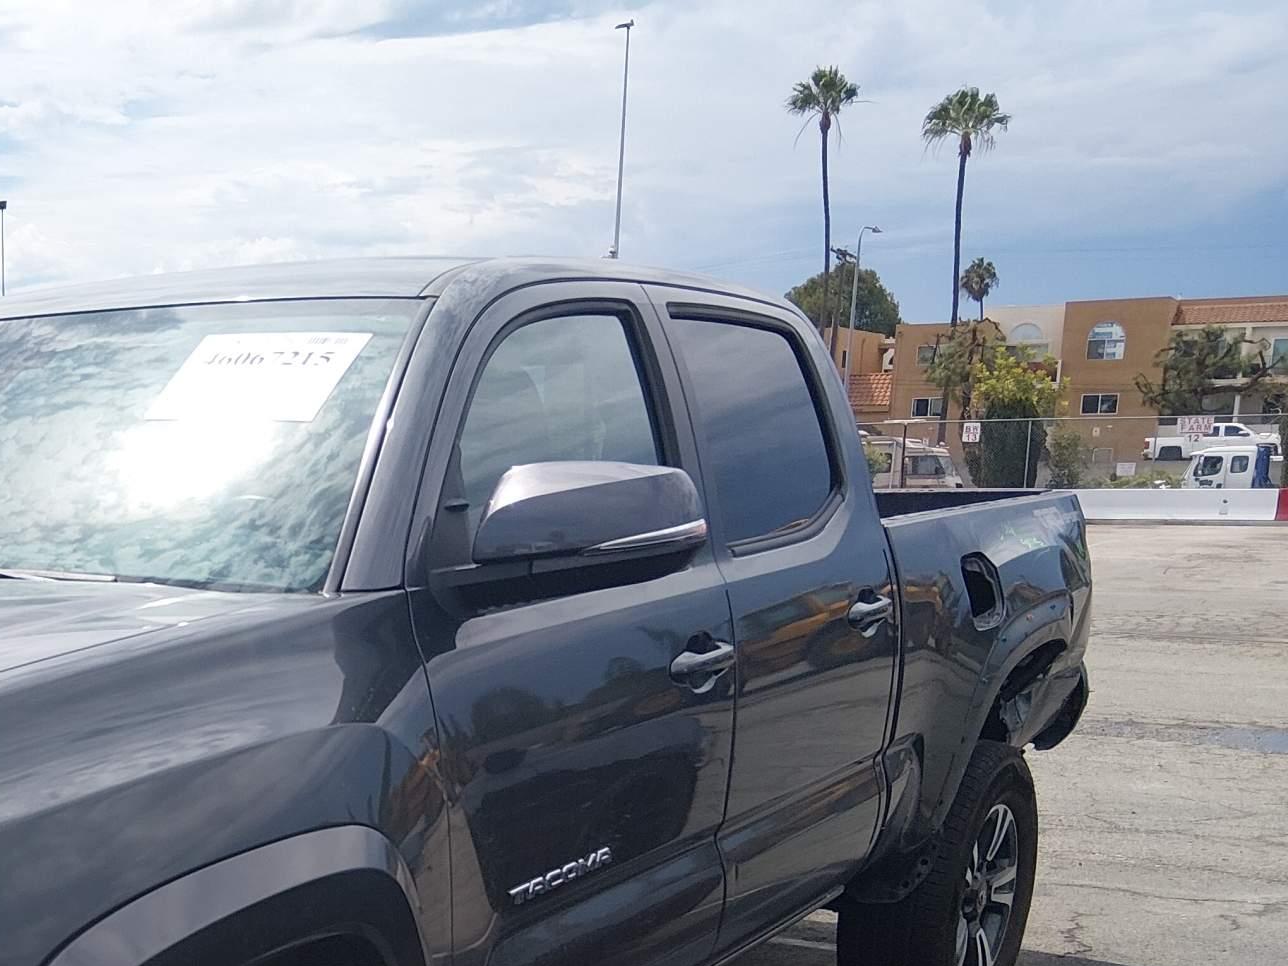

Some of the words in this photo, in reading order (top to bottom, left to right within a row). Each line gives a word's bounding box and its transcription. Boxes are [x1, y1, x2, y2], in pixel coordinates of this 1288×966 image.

[1179, 416, 1213, 425] STATE
[1180, 424, 1211, 432] FARM
[1187, 434, 1200, 442] 12
[508, 847, 612, 904] TACOMA
